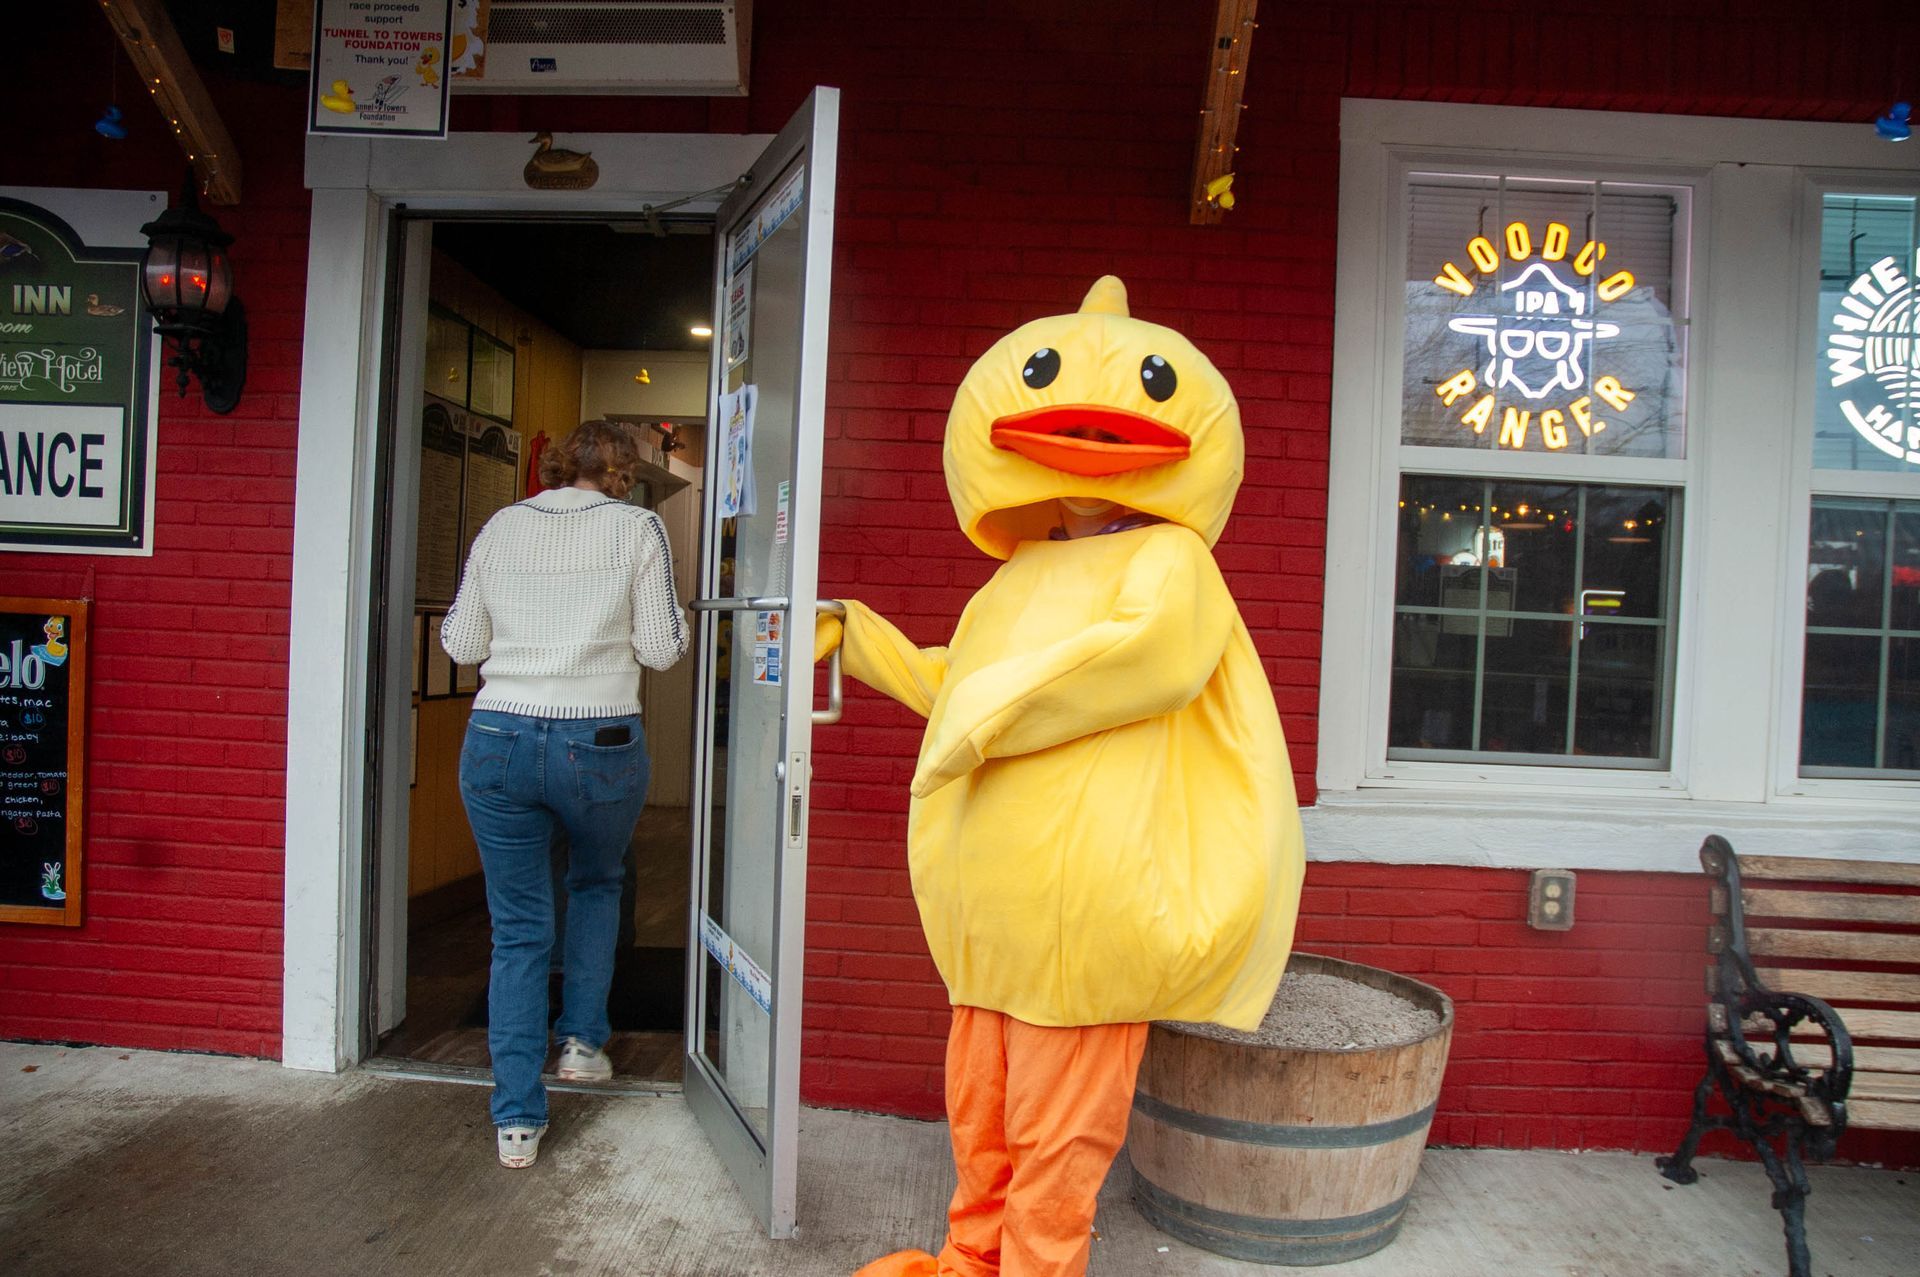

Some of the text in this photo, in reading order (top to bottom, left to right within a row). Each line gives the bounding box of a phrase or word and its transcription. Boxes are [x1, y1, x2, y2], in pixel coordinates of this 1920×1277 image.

[349, 3, 420, 13] race proceeds
[365, 15, 403, 25] support
[323, 28, 443, 42] TUNNEL TO TOWERS
[344, 39, 421, 51] FOUNDATION
[355, 54, 409, 66] Thank you!
[354, 103, 407, 112] unnel Towers
[359, 112, 396, 121] Foundation
[1433, 221, 1637, 303] VOODOO
[12, 283, 72, 315] INN
[1515, 290, 1560, 315] IPA
[1827, 256, 1908, 388] WHITE
[41, 347, 104, 393] Hotel
[1433, 368, 1637, 450] RANGER
[0, 771, 37, 780] heddar,
